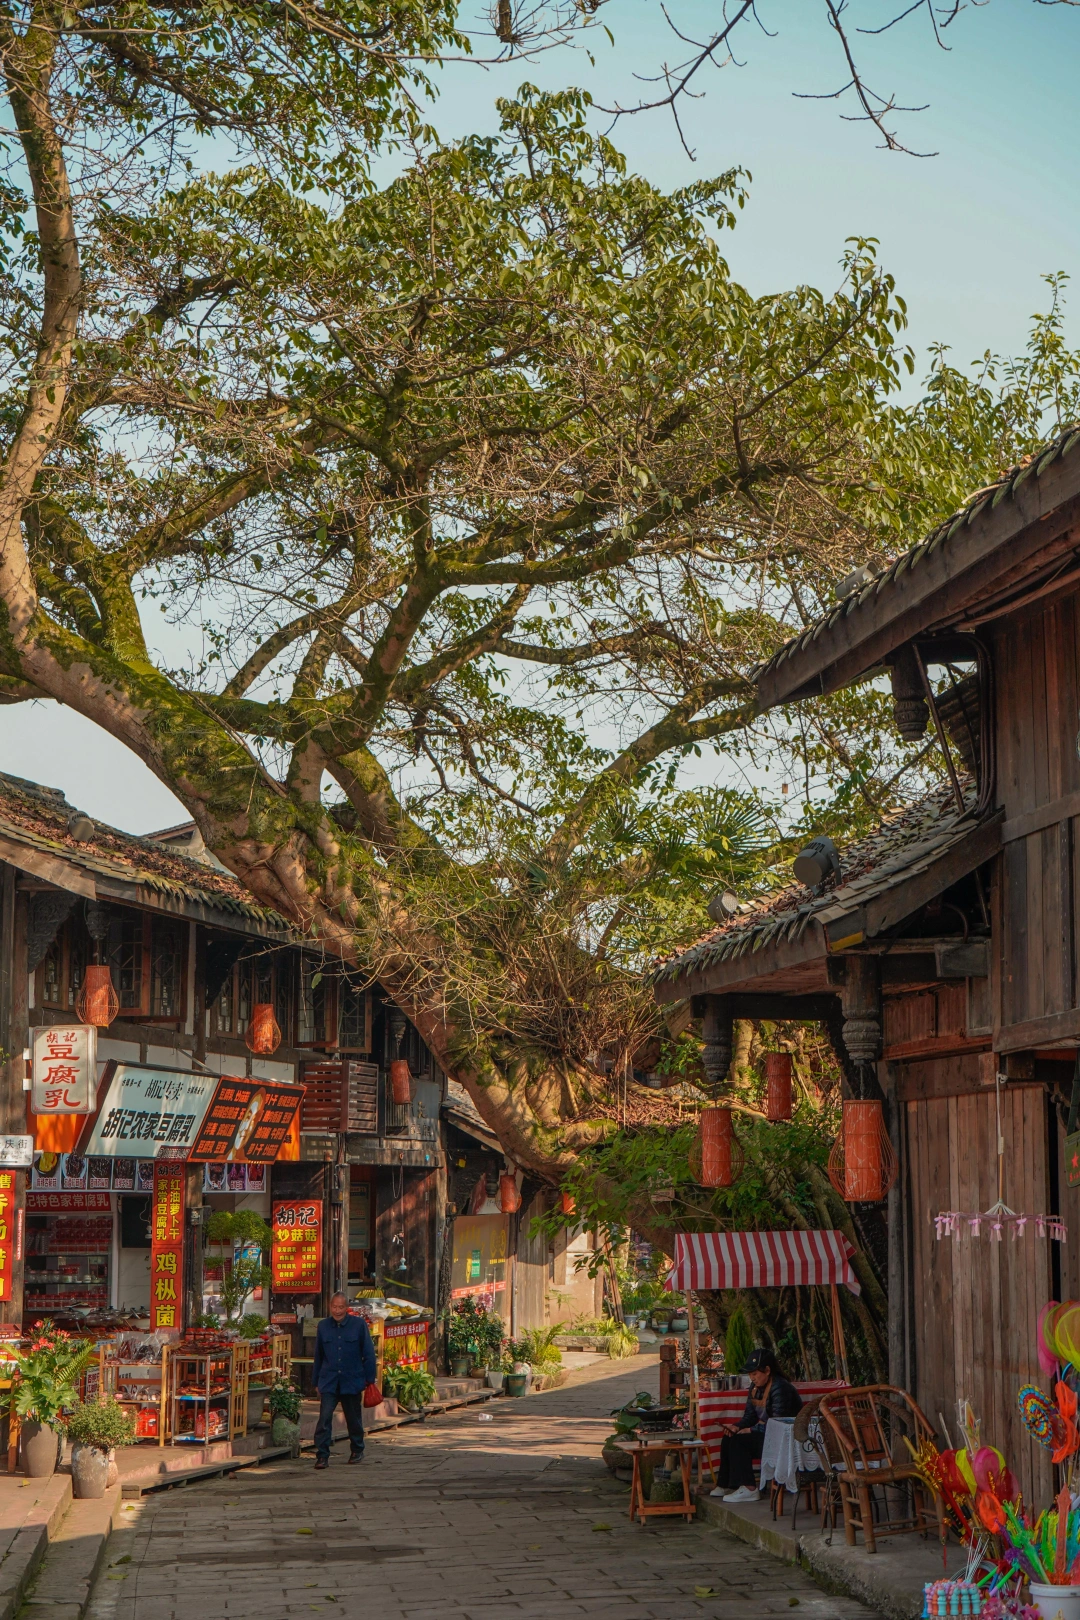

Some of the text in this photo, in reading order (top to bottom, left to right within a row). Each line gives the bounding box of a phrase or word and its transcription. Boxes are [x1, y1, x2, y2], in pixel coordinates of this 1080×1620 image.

[46, 1032, 78, 1044] 胡記
[42, 1044, 81, 1108] 豆腐乳
[144, 1079, 184, 1101] 胡记专卖
[100, 1108, 196, 1142] 胡记农家豆腐乳
[0, 1139, 27, 1149] 庆街
[157, 1164, 183, 1177] 胡记
[156, 1178, 168, 1240] 家常豆腐乳
[169, 1178, 181, 1240] 红油萝卜干
[276, 1206, 320, 1227] 胡记
[277, 1228, 318, 1242] 炒菇菇
[155, 1252, 178, 1327] 鸡枞菌
